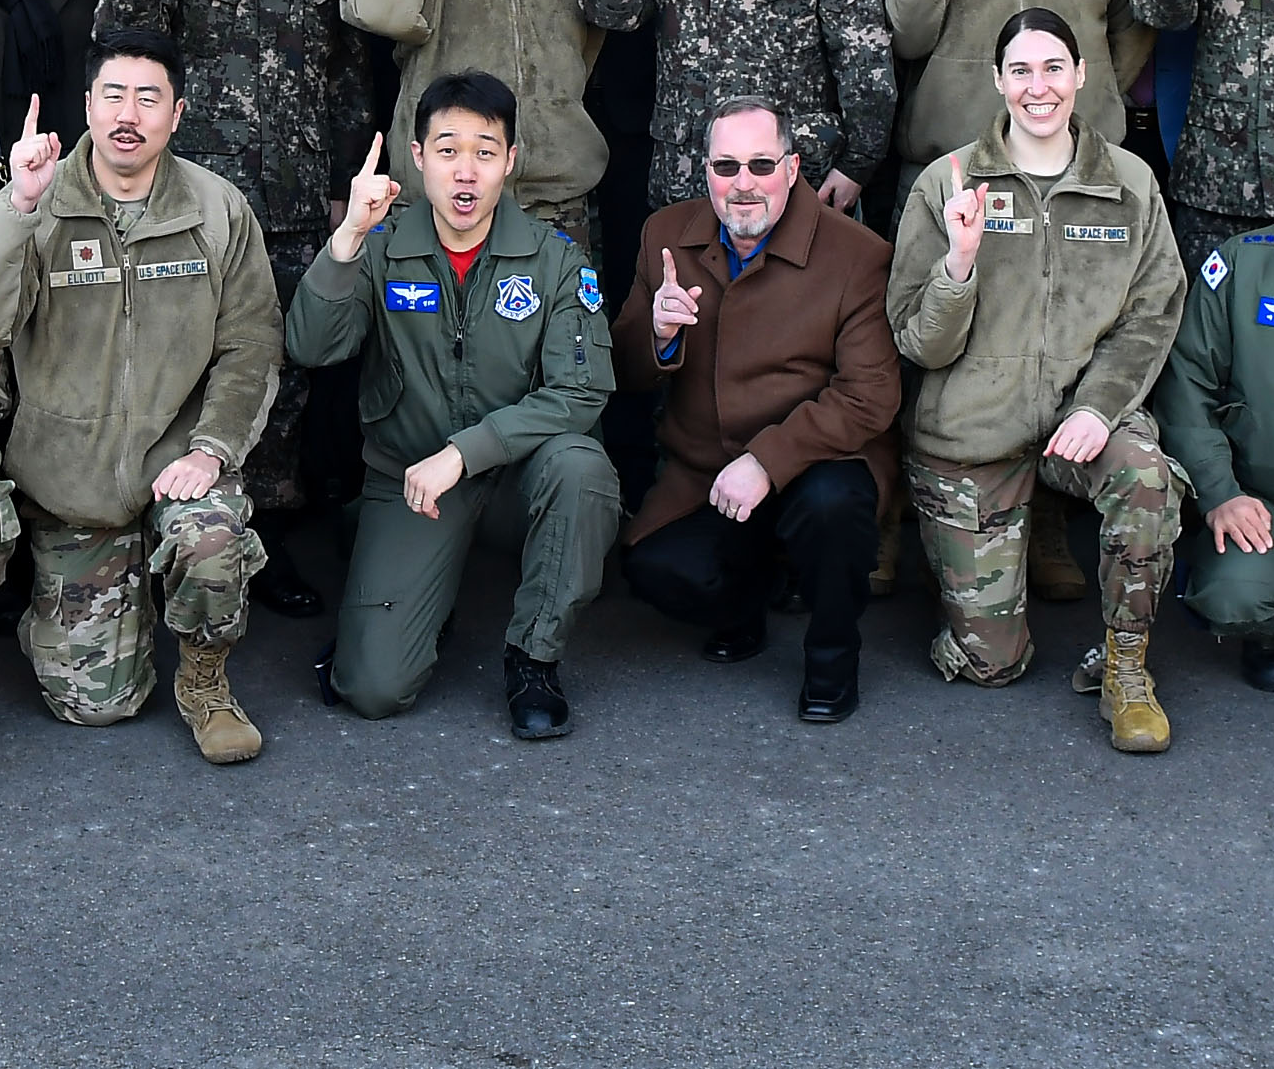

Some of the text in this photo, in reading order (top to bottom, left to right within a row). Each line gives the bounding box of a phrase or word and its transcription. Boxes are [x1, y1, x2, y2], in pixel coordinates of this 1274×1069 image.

[984, 219, 1015, 232] HOLMAN
[1078, 228, 1102, 240] SPACE
[1104, 229, 1127, 241] FORCE
[156, 264, 180, 277] SPACE
[181, 261, 206, 276] FORCE
[67, 270, 106, 284] ELLIOTT
